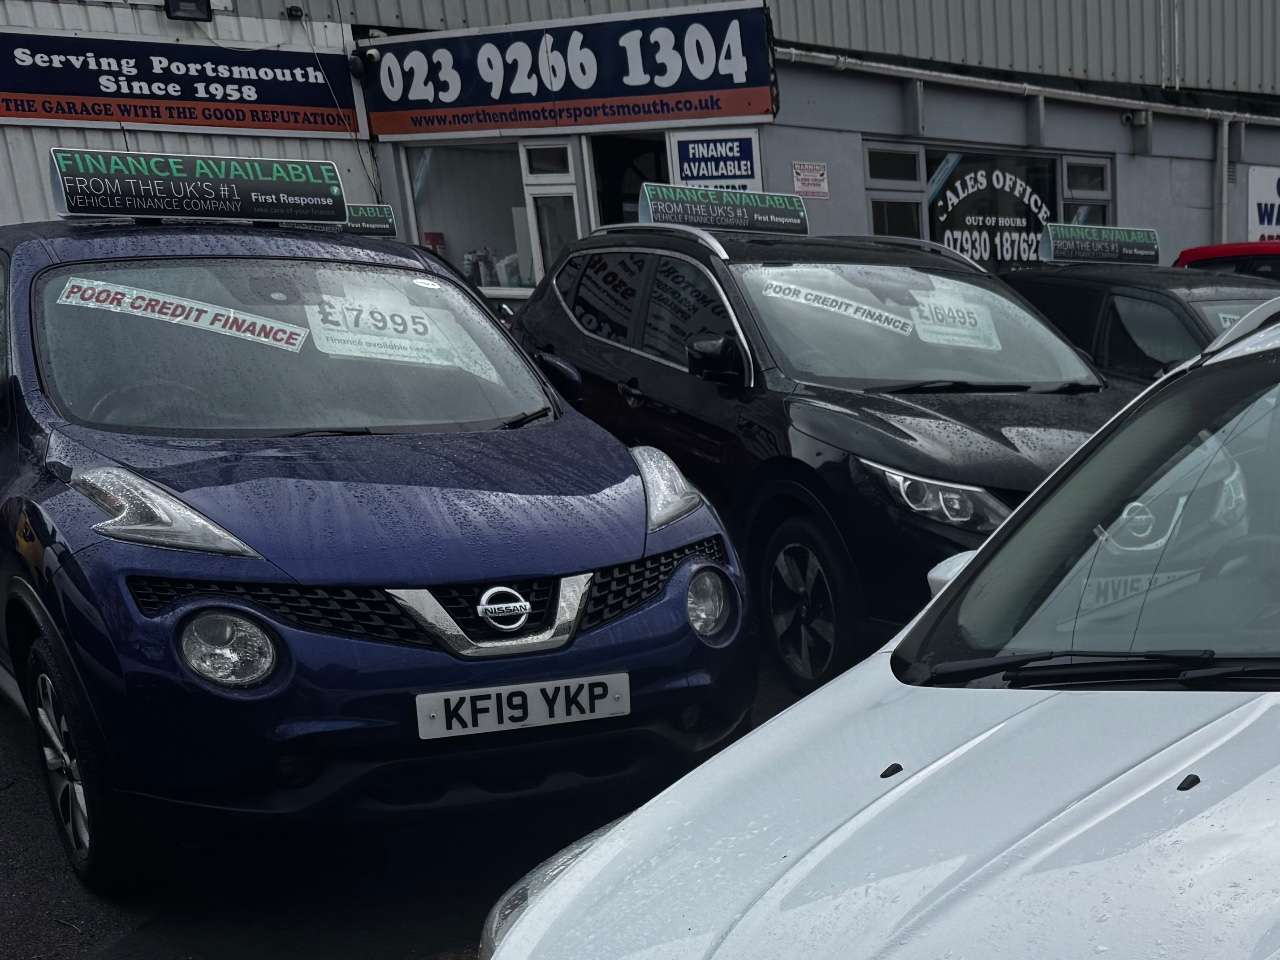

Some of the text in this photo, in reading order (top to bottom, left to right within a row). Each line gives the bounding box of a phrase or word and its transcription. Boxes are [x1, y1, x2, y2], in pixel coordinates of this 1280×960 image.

[13, 48, 326, 84] Serving Portsmouth
[380, 19, 748, 103] 023 9266 1304
[98, 75, 258, 101] Since 1958
[2, 98, 38, 113] THE
[42, 100, 113, 115] GARAGE
[117, 103, 161, 118] WITH
[165, 104, 198, 120] THE
[202, 107, 246, 122] GOOD
[410, 95, 722, 127] www.northendmotorsportsmouth.co.uk
[688, 141, 740, 158] FINANCE
[55, 152, 339, 184] FINANCE AVAILABLE
[681, 161, 752, 177] AVAILABLE!
[63, 176, 241, 200] FROM THE UK'S #1
[251, 192, 334, 206] First Response
[650, 185, 718, 204] FINANCE
[722, 191, 801, 210] AVAILABLE
[992, 169, 1051, 227] OFFICE
[67, 196, 125, 208] VEHICLE
[126, 197, 181, 210] FINANCE
[183, 199, 242, 213] COMPANY
[651, 201, 683, 214] FROM
[685, 203, 708, 216] THE
[709, 205, 735, 218] UK'S
[965, 216, 1027, 227] OUT OF HOURS
[944, 229, 991, 261] 07930
[65, 284, 302, 347] POOR CREDIT FINANCE
[318, 300, 430, 337] £7995
[763, 281, 911, 334] POOR CREDIT FINANCE
[485, 604, 528, 615] NISSAN
[444, 682, 609, 731] KF19 YKP
